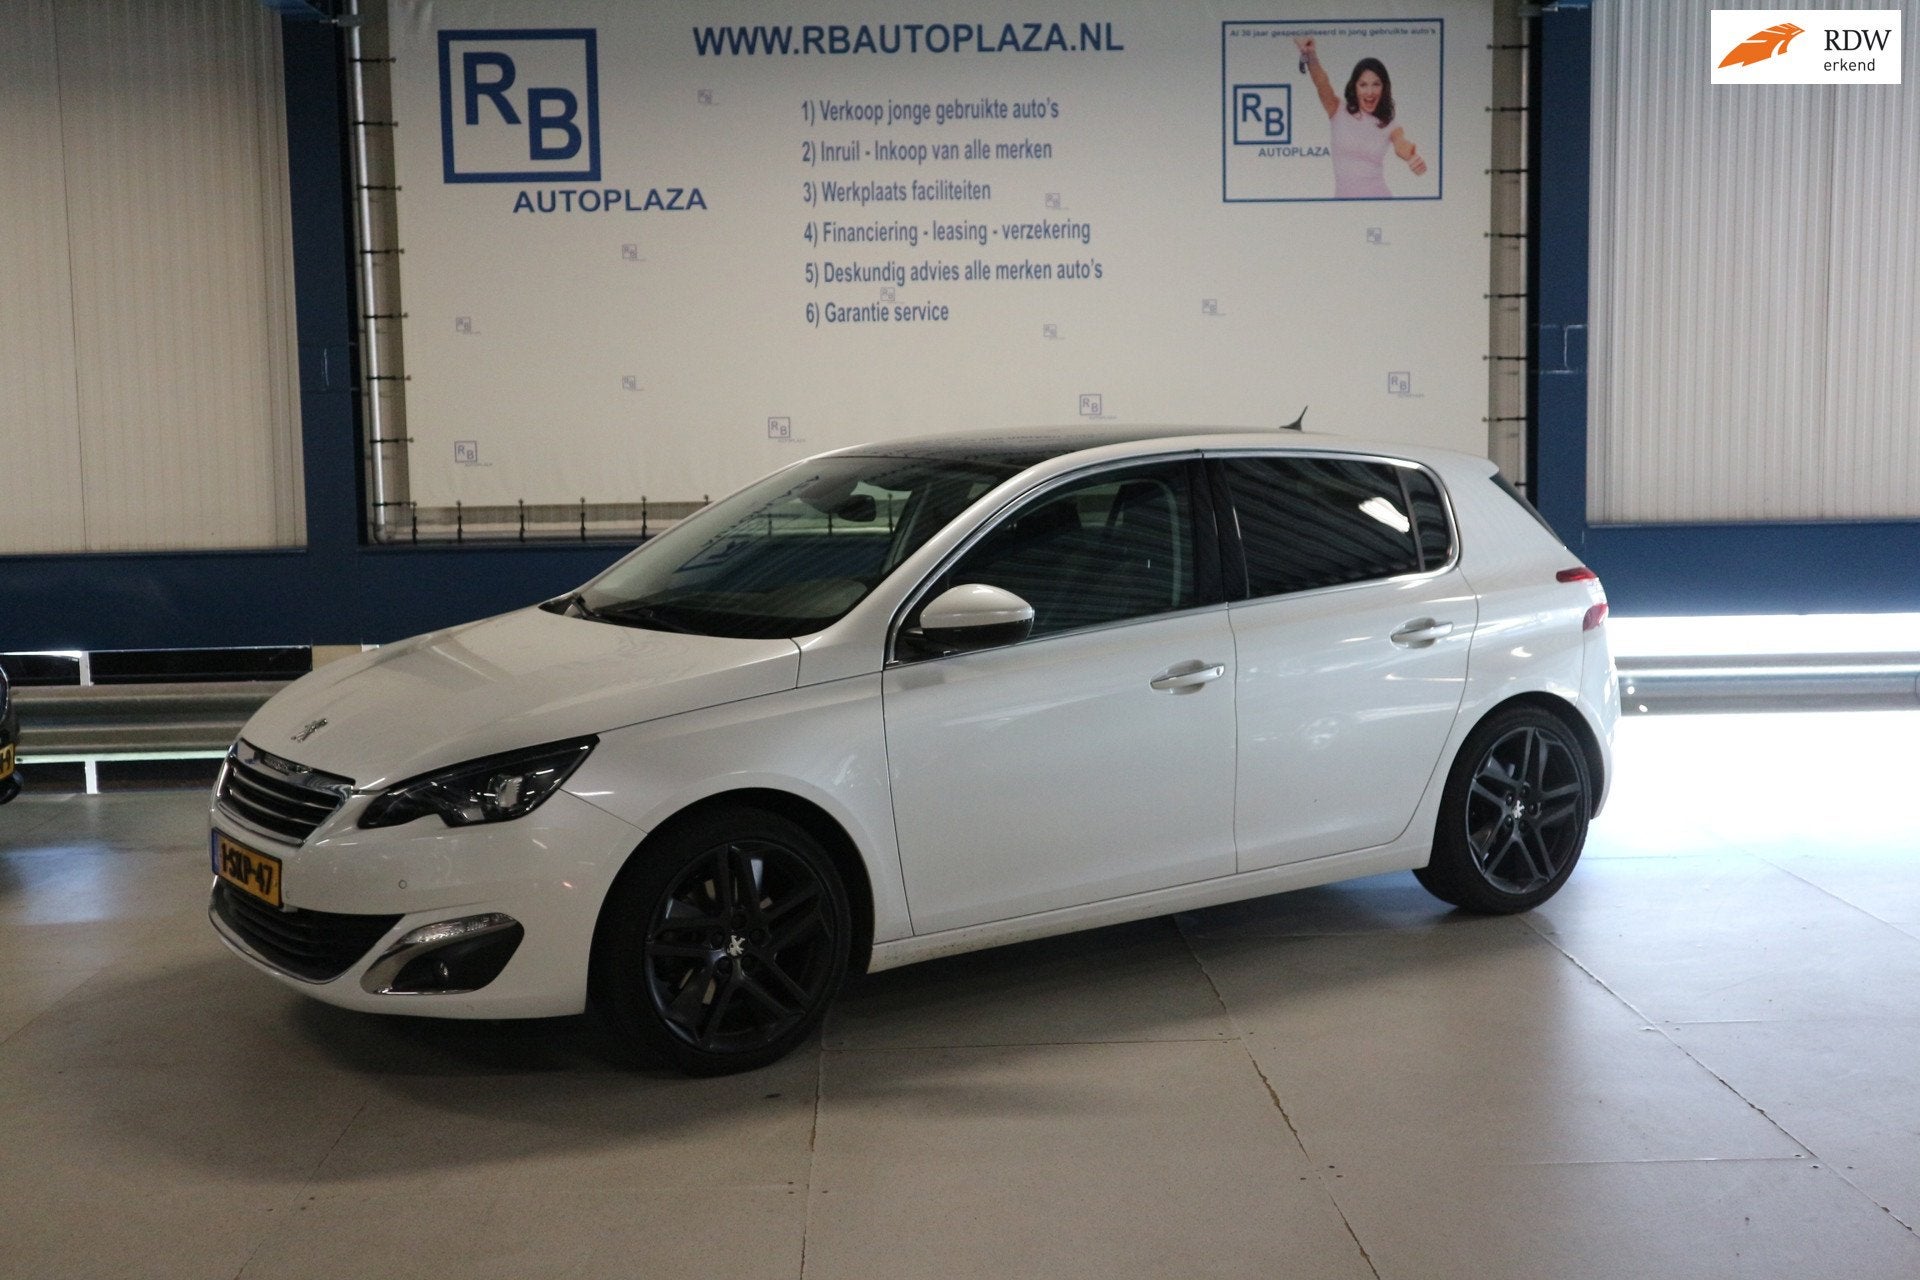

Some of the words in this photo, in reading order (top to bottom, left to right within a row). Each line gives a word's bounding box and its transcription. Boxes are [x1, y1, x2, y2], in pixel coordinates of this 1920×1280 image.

[692, 22, 1125, 57] WWW.RBAUTOPLAZA.NL
[462, 51, 583, 161] RB
[801, 100, 816, 127] 1)
[819, 99, 884, 127] Verkoop
[887, 98, 932, 126] jonge
[935, 98, 1009, 126] gebruikte
[1012, 97, 1060, 120] auto's
[1241, 92, 1286, 137] RB
[801, 140, 817, 168] 2)
[820, 140, 861, 163] Inruil
[874, 140, 928, 166] Inkoop
[932, 143, 960, 161] van
[964, 138, 991, 161] alle
[995, 138, 1053, 160] merken
[1257, 146, 1331, 158] AUTOPLAZA
[512, 187, 708, 214] AUTOPLAZA
[803, 181, 818, 208] 3)
[821, 180, 908, 208] Werkplaats
[911, 178, 991, 202] faciliteiten
[803, 221, 819, 249] 4)
[822, 220, 919, 248] Financiering
[932, 220, 988, 247] leasing
[1001, 218, 1091, 246] verzekering
[804, 262, 820, 289] 5)
[823, 261, 906, 288] Deskundig
[910, 259, 960, 283] advies
[964, 259, 991, 282] alle
[995, 259, 1052, 281] merken
[1056, 258, 1104, 281] auto's
[805, 302, 820, 329] 6)
[824, 301, 890, 325] Garantie
[894, 301, 949, 323] service
